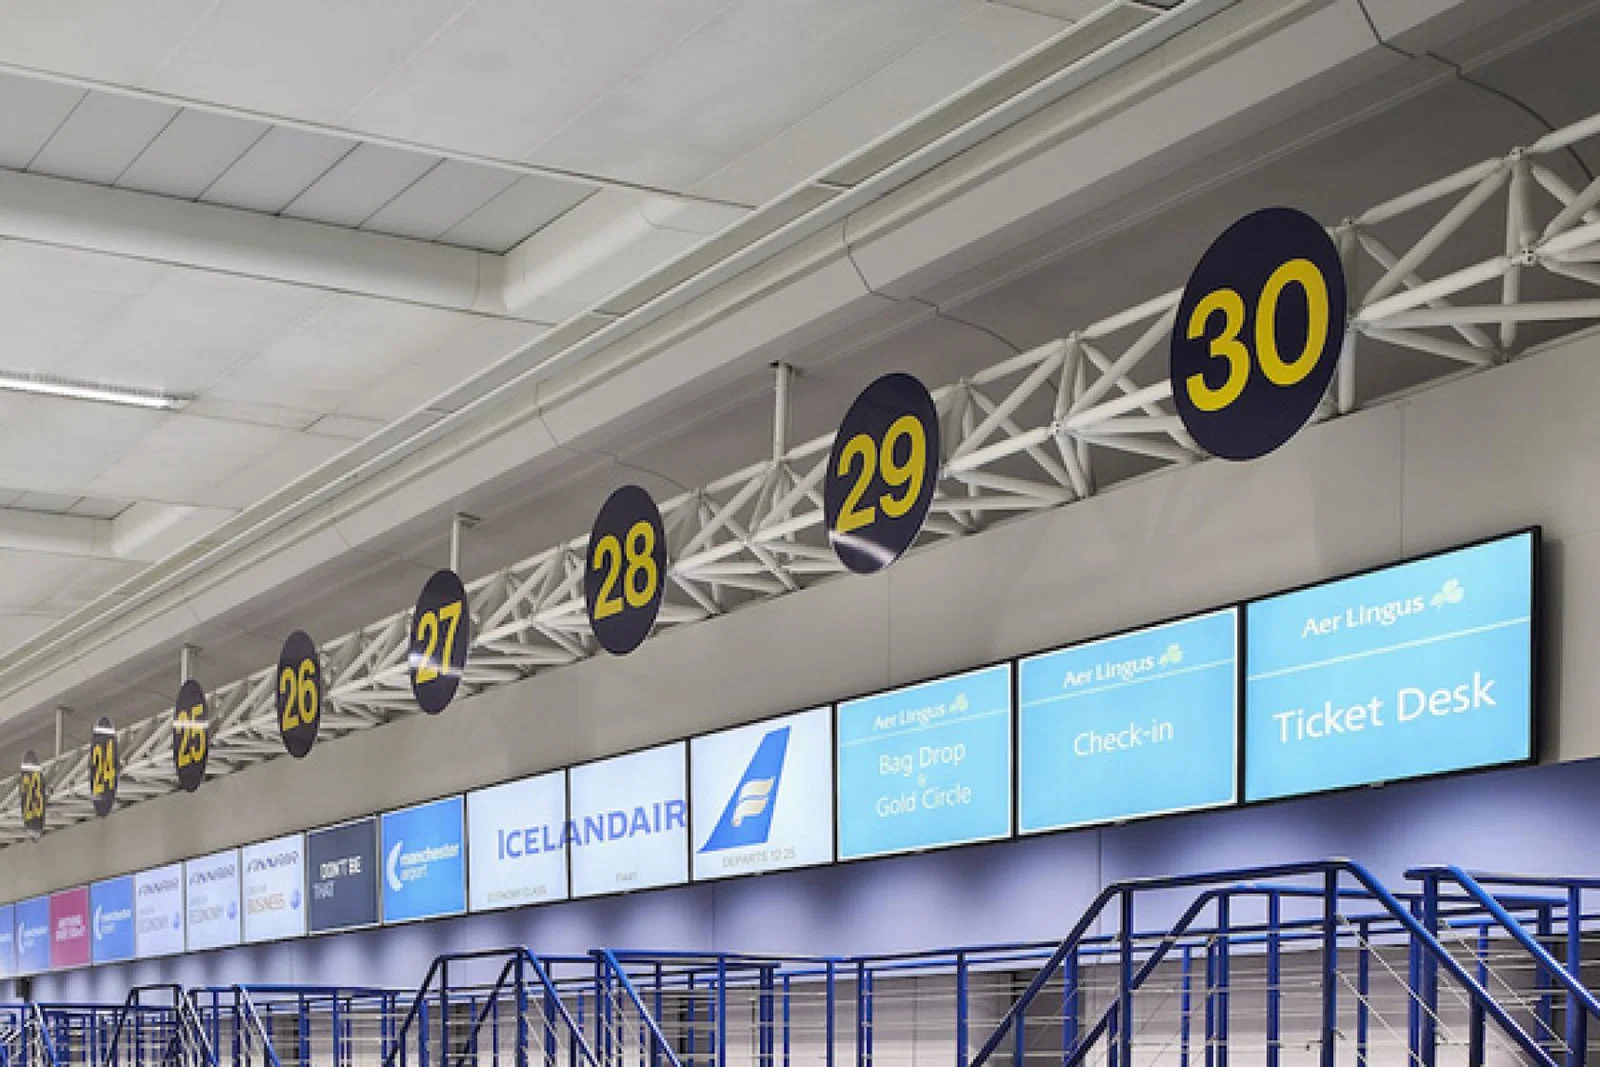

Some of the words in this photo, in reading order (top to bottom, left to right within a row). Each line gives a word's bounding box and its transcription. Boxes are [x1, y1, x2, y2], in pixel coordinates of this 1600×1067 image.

[1186, 257, 1330, 412] 30
[834, 415, 928, 534] 29
[593, 520, 658, 620] 28
[415, 602, 462, 684] 27
[1301, 615, 1342, 638] Aer
[1346, 594, 1425, 627] Lingus
[280, 658, 319, 731] 26
[1063, 669, 1093, 688] Aer
[1095, 655, 1154, 683] Lingus
[178, 704, 207, 768] 25
[873, 714, 897, 731] Aer
[898, 704, 946, 726] Lingus
[1272, 696, 1384, 744] Ticket
[1397, 671, 1497, 723] Desk
[92, 738, 115, 796] 24
[879, 753, 913, 777] Bag
[919, 743, 967, 768] Drop
[1073, 719, 1175, 757] Check-in
[22, 769, 43, 820] 23
[876, 792, 916, 818] Gold
[922, 782, 972, 809] Circle
[498, 799, 688, 861] ICELANDAIR
